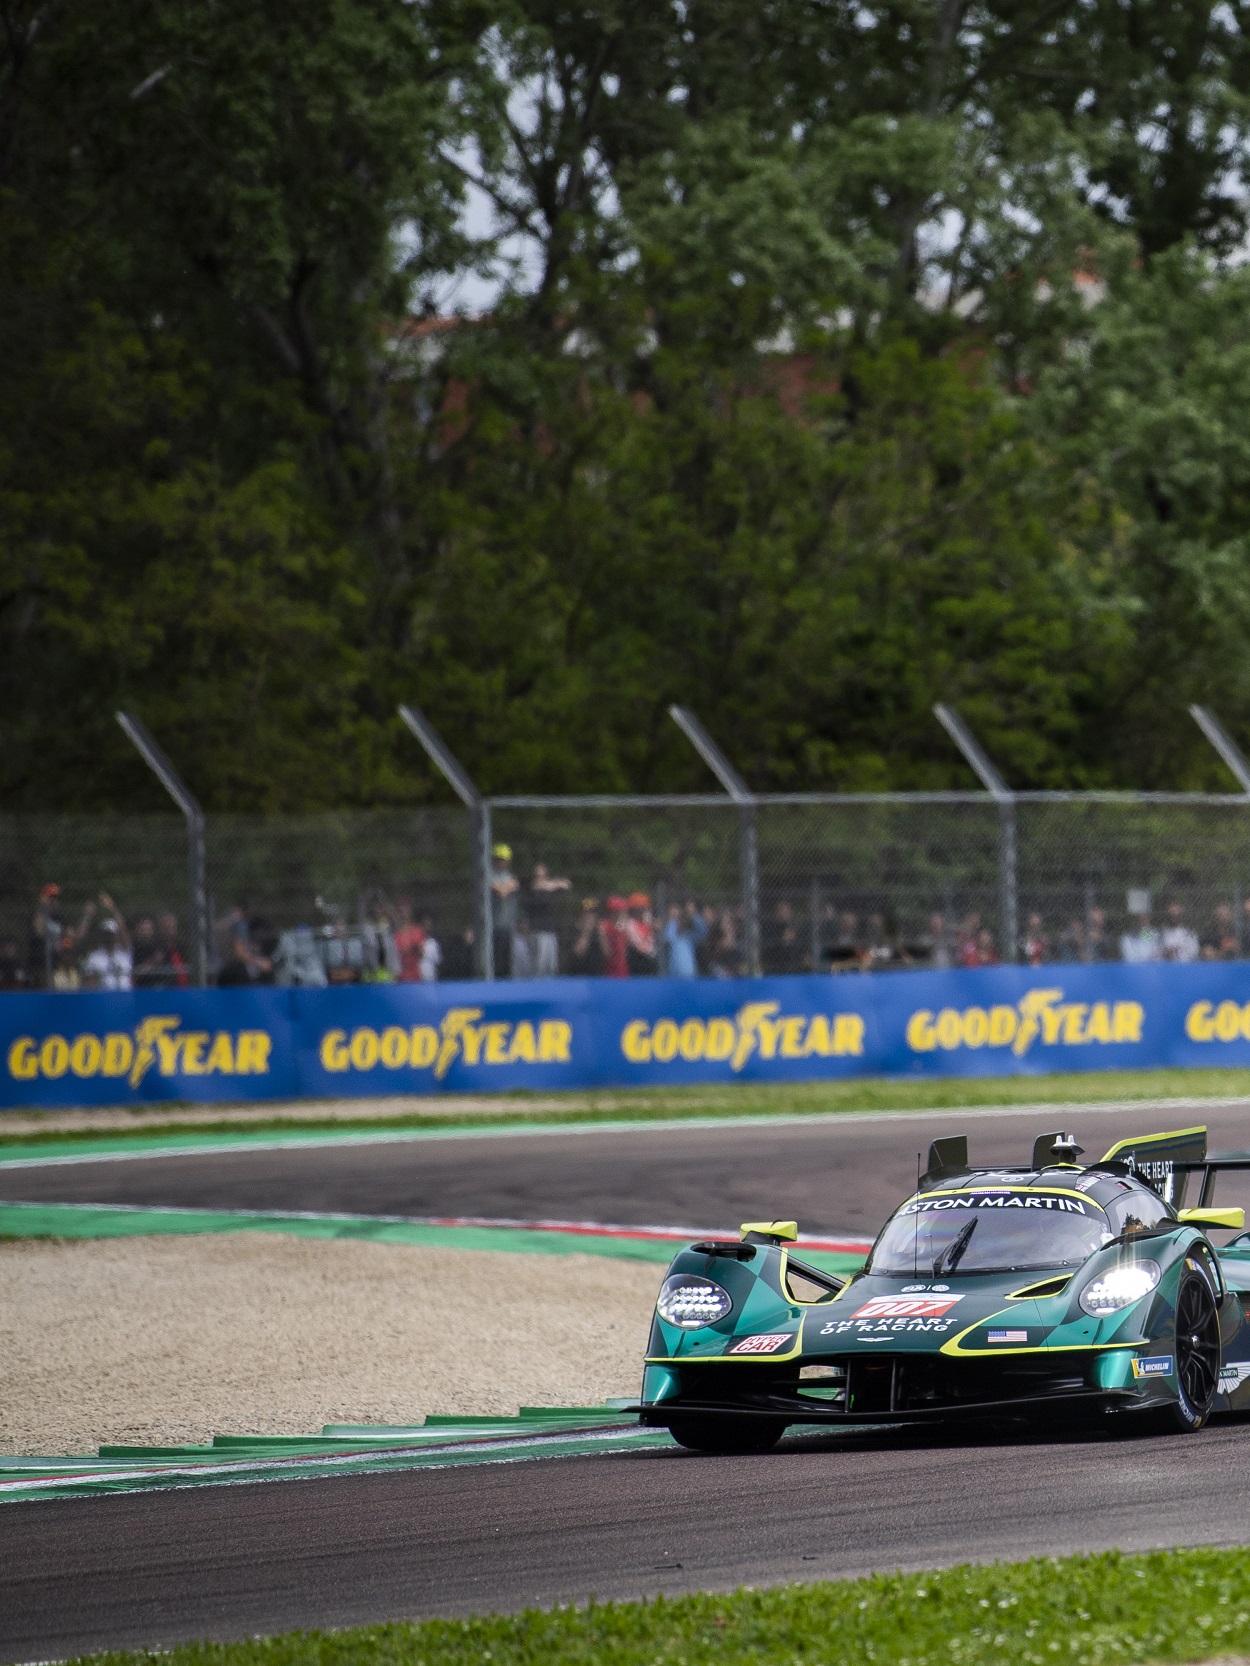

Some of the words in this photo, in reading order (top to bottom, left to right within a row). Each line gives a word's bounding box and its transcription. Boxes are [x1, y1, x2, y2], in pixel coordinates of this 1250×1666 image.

[907, 998, 1144, 1054] GOODYEAR
[320, 1016, 572, 1074] GOODYEAR
[621, 1011, 864, 1065] GOODYEAR
[8, 1026, 272, 1081] GOODYEAR
[1152, 1161, 1173, 1179] HEART
[894, 1197, 975, 1217] ASTON
[979, 1197, 1087, 1215] MARTIN
[856, 1301, 953, 1317] 007
[820, 1326, 851, 1335] OF
[858, 1324, 949, 1332] RACING
[825, 1319, 871, 1328] THE
[878, 1317, 958, 1325] HEART
[737, 1341, 779, 1352] CAR
[1145, 1362, 1169, 1372] MICHELIN
